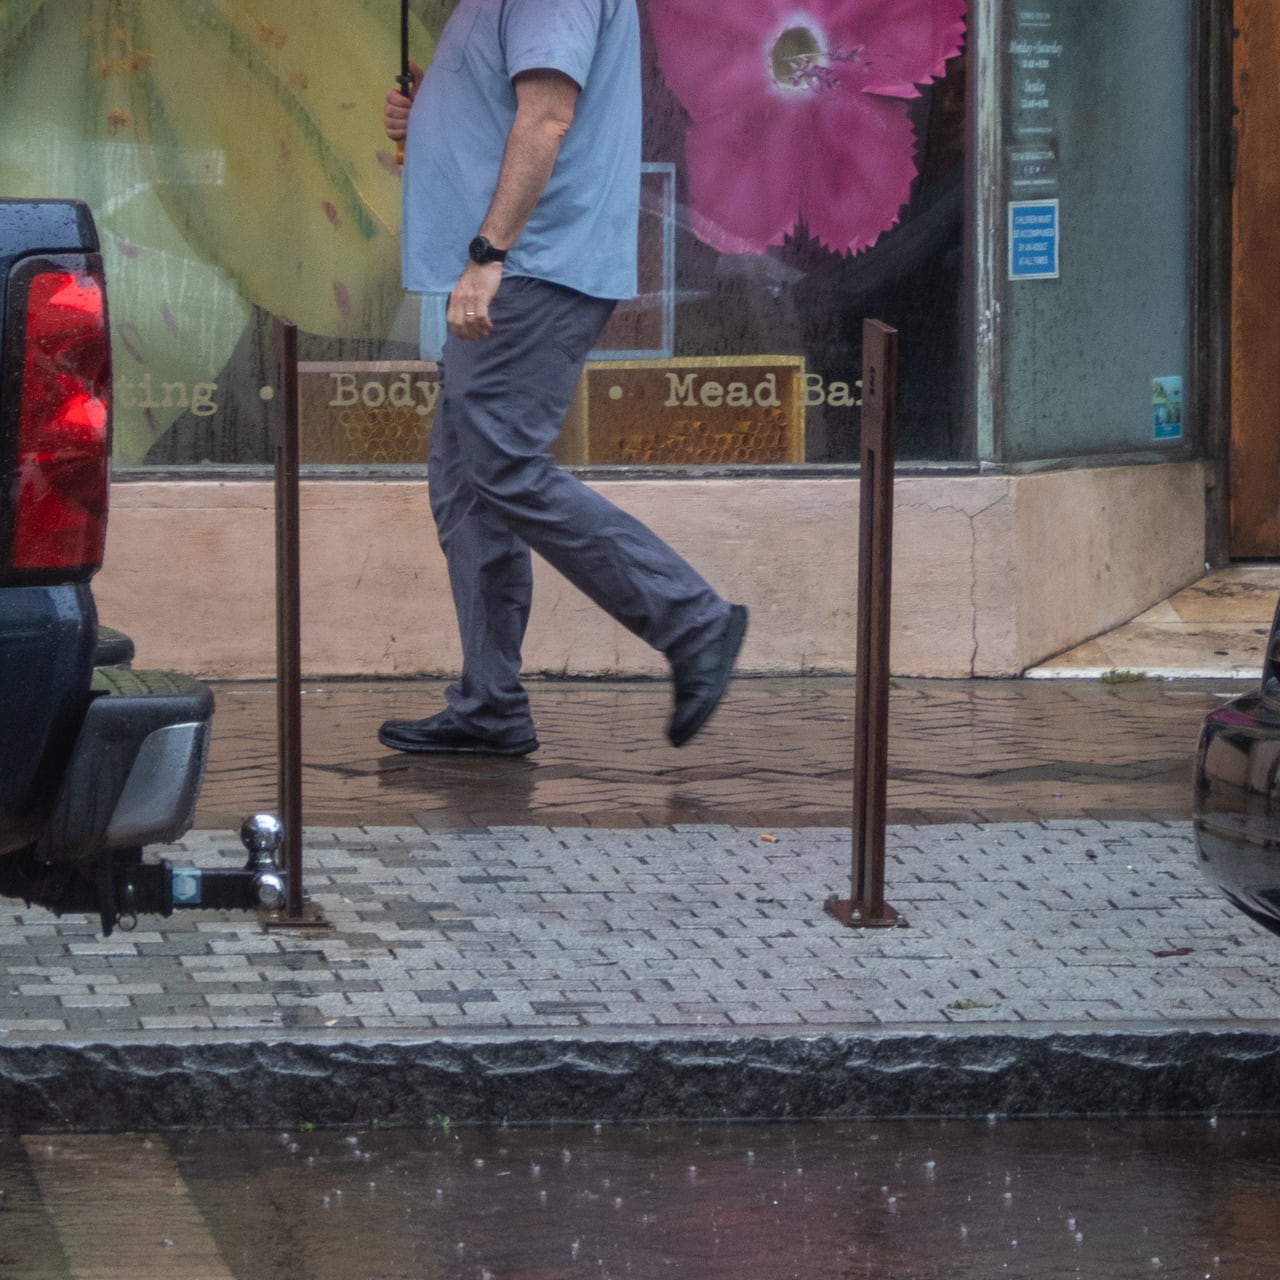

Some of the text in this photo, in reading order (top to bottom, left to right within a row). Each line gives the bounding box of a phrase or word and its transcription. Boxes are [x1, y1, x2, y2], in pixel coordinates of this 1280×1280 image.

[328, 372, 440, 416] Body
[664, 372, 782, 408] Mead
[795, 372, 862, 408] Ba
